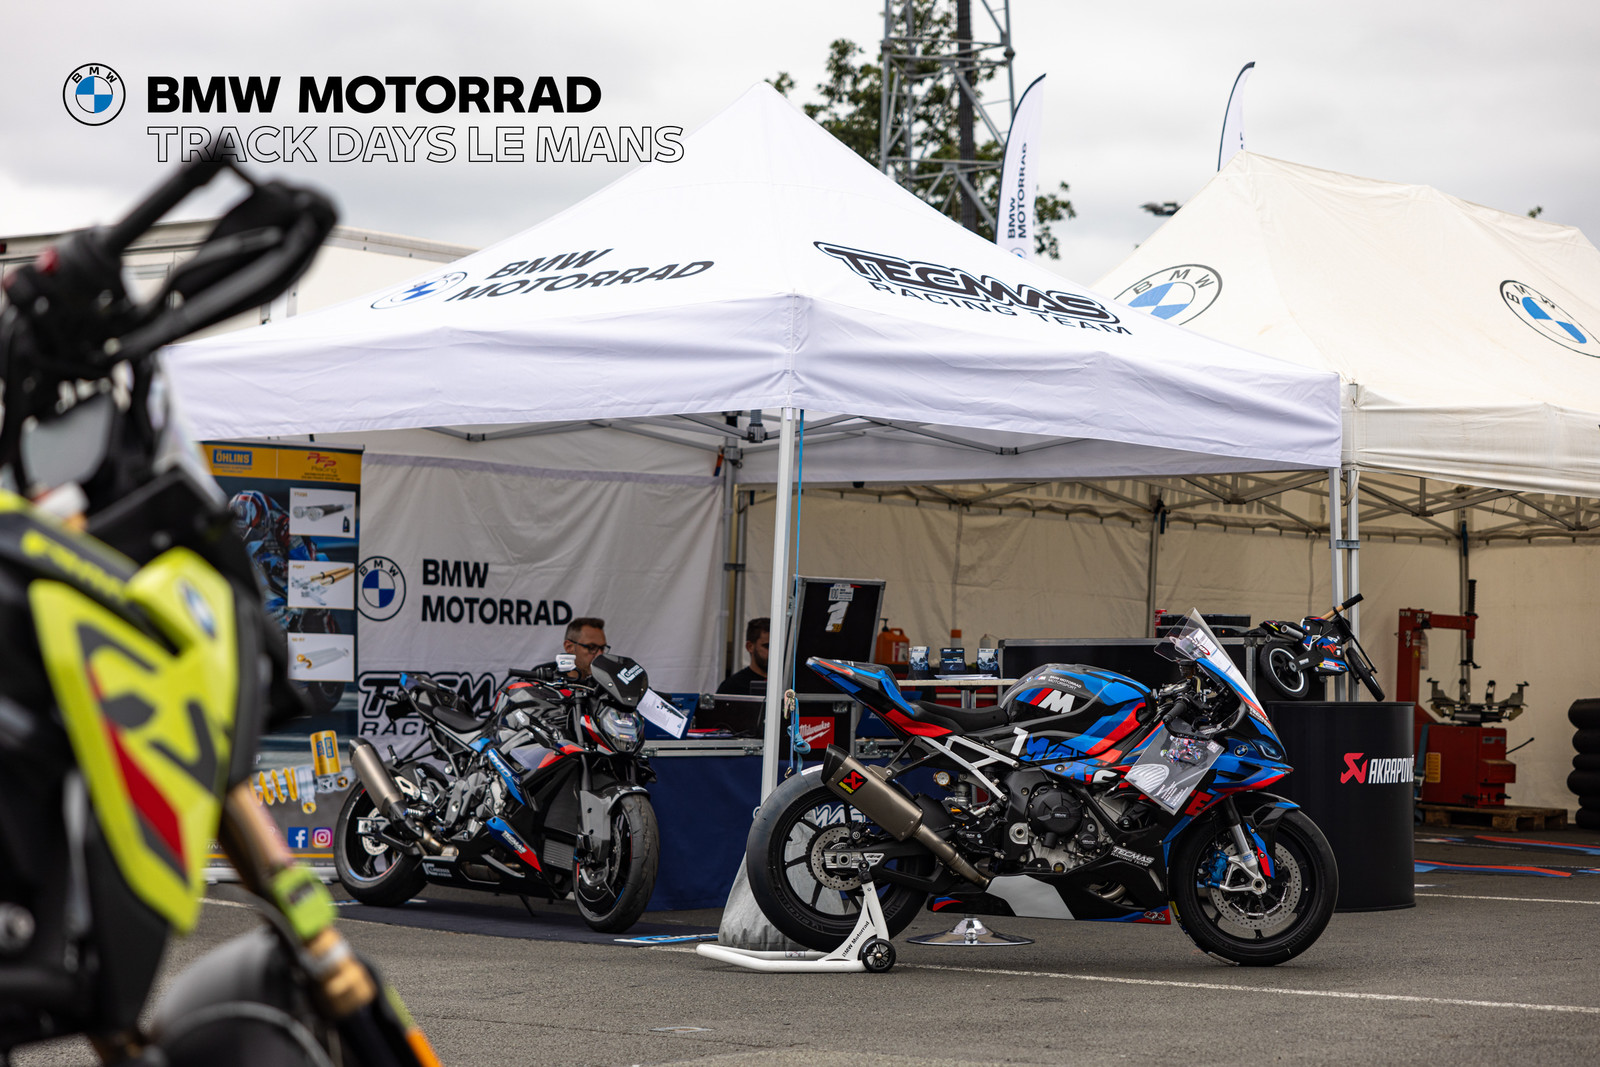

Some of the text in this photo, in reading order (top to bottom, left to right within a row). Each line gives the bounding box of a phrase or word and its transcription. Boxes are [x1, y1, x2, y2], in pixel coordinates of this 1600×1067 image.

[1017, 142, 1028, 239] MOTORRAD
[1007, 197, 1016, 239] BMW
[485, 248, 614, 280] BMW
[444, 260, 715, 303] MOTORRAD
[1132, 268, 1215, 295] BMW
[868, 281, 1133, 336] RACING TEAM
[215, 449, 251, 465] ÖHLINS
[359, 559, 400, 578] BMW
[422, 558, 489, 588] BMW
[421, 595, 573, 626] MOTORRAD
[1037, 689, 1075, 714] M
[1113, 845, 1155, 864] TECMAS
[852, 920, 870, 945] Motorrad
